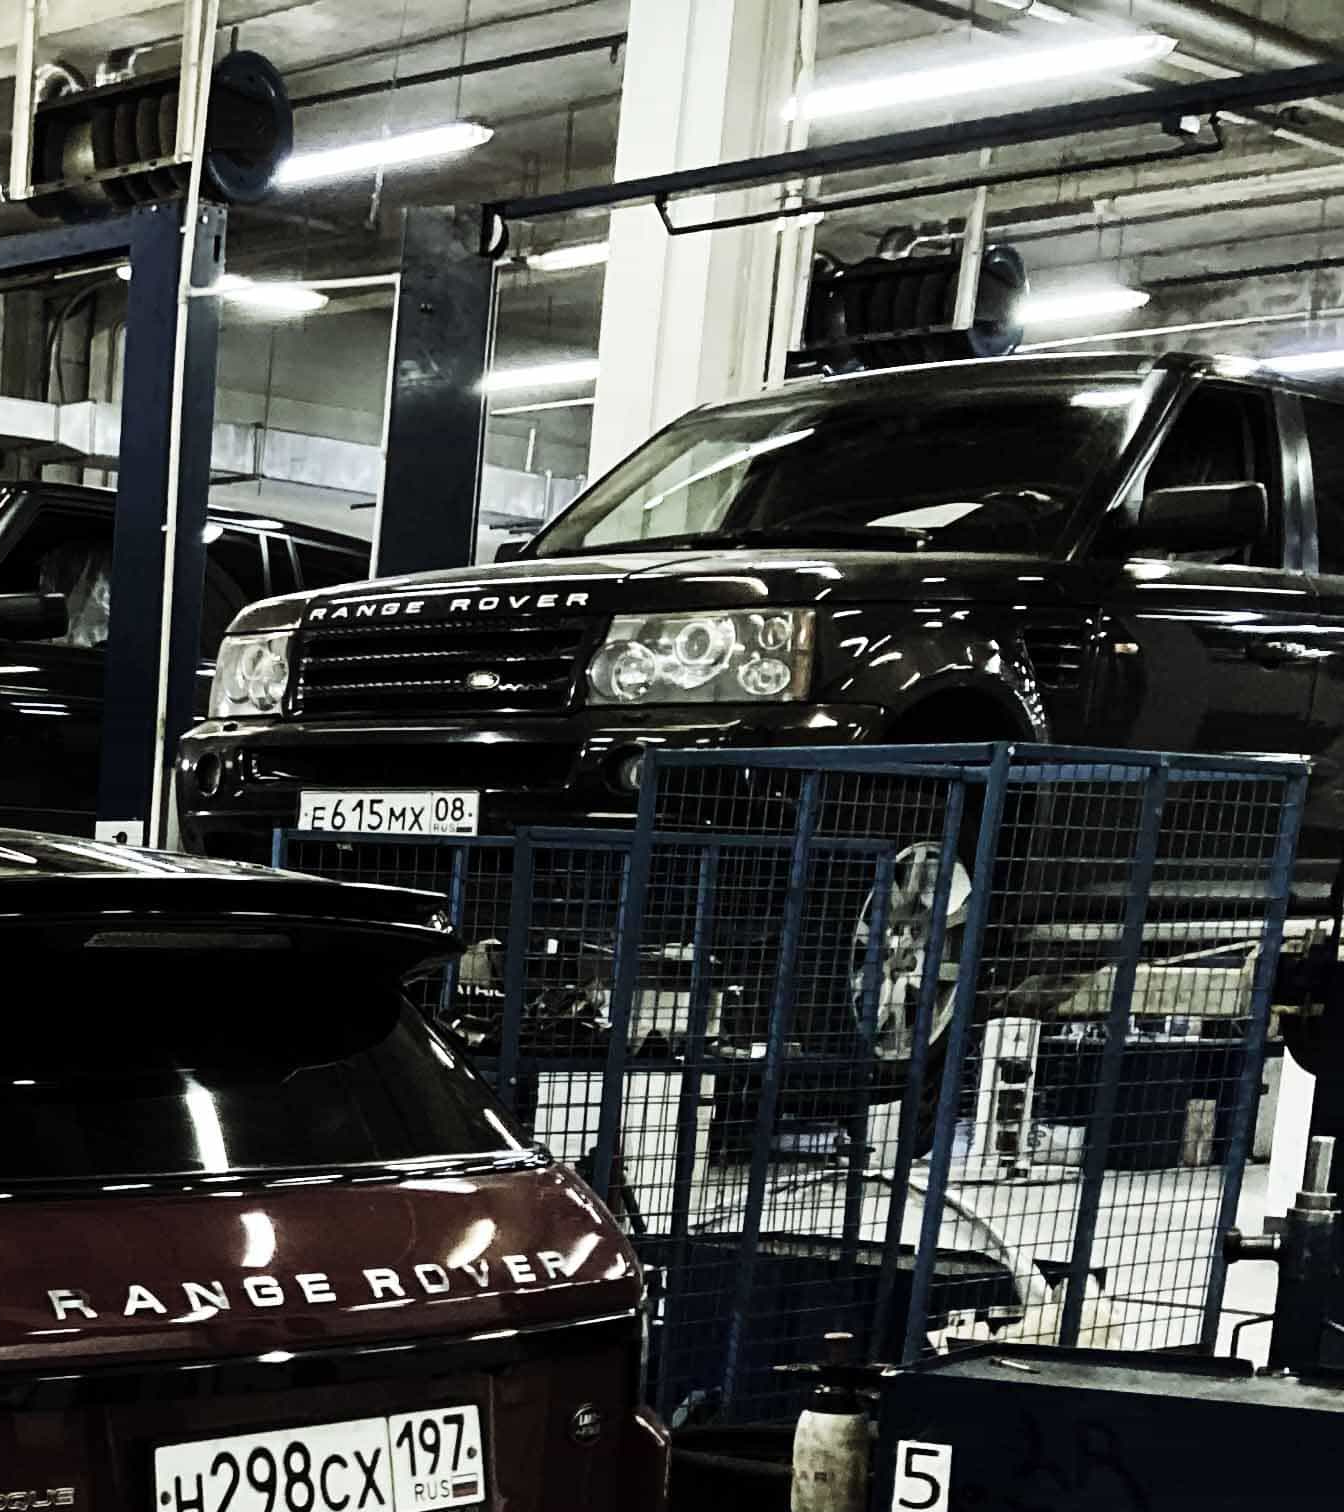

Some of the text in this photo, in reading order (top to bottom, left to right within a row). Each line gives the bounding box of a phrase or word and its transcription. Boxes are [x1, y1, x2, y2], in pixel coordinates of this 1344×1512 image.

[309, 592, 590, 621] RANGE ROVER
[434, 797, 465, 822] 08
[47, 1249, 575, 1321] RANGE ROVER
[395, 1413, 464, 1478] 197
[414, 1479, 450, 1501] RUS
[898, 1446, 942, 1510] 5
